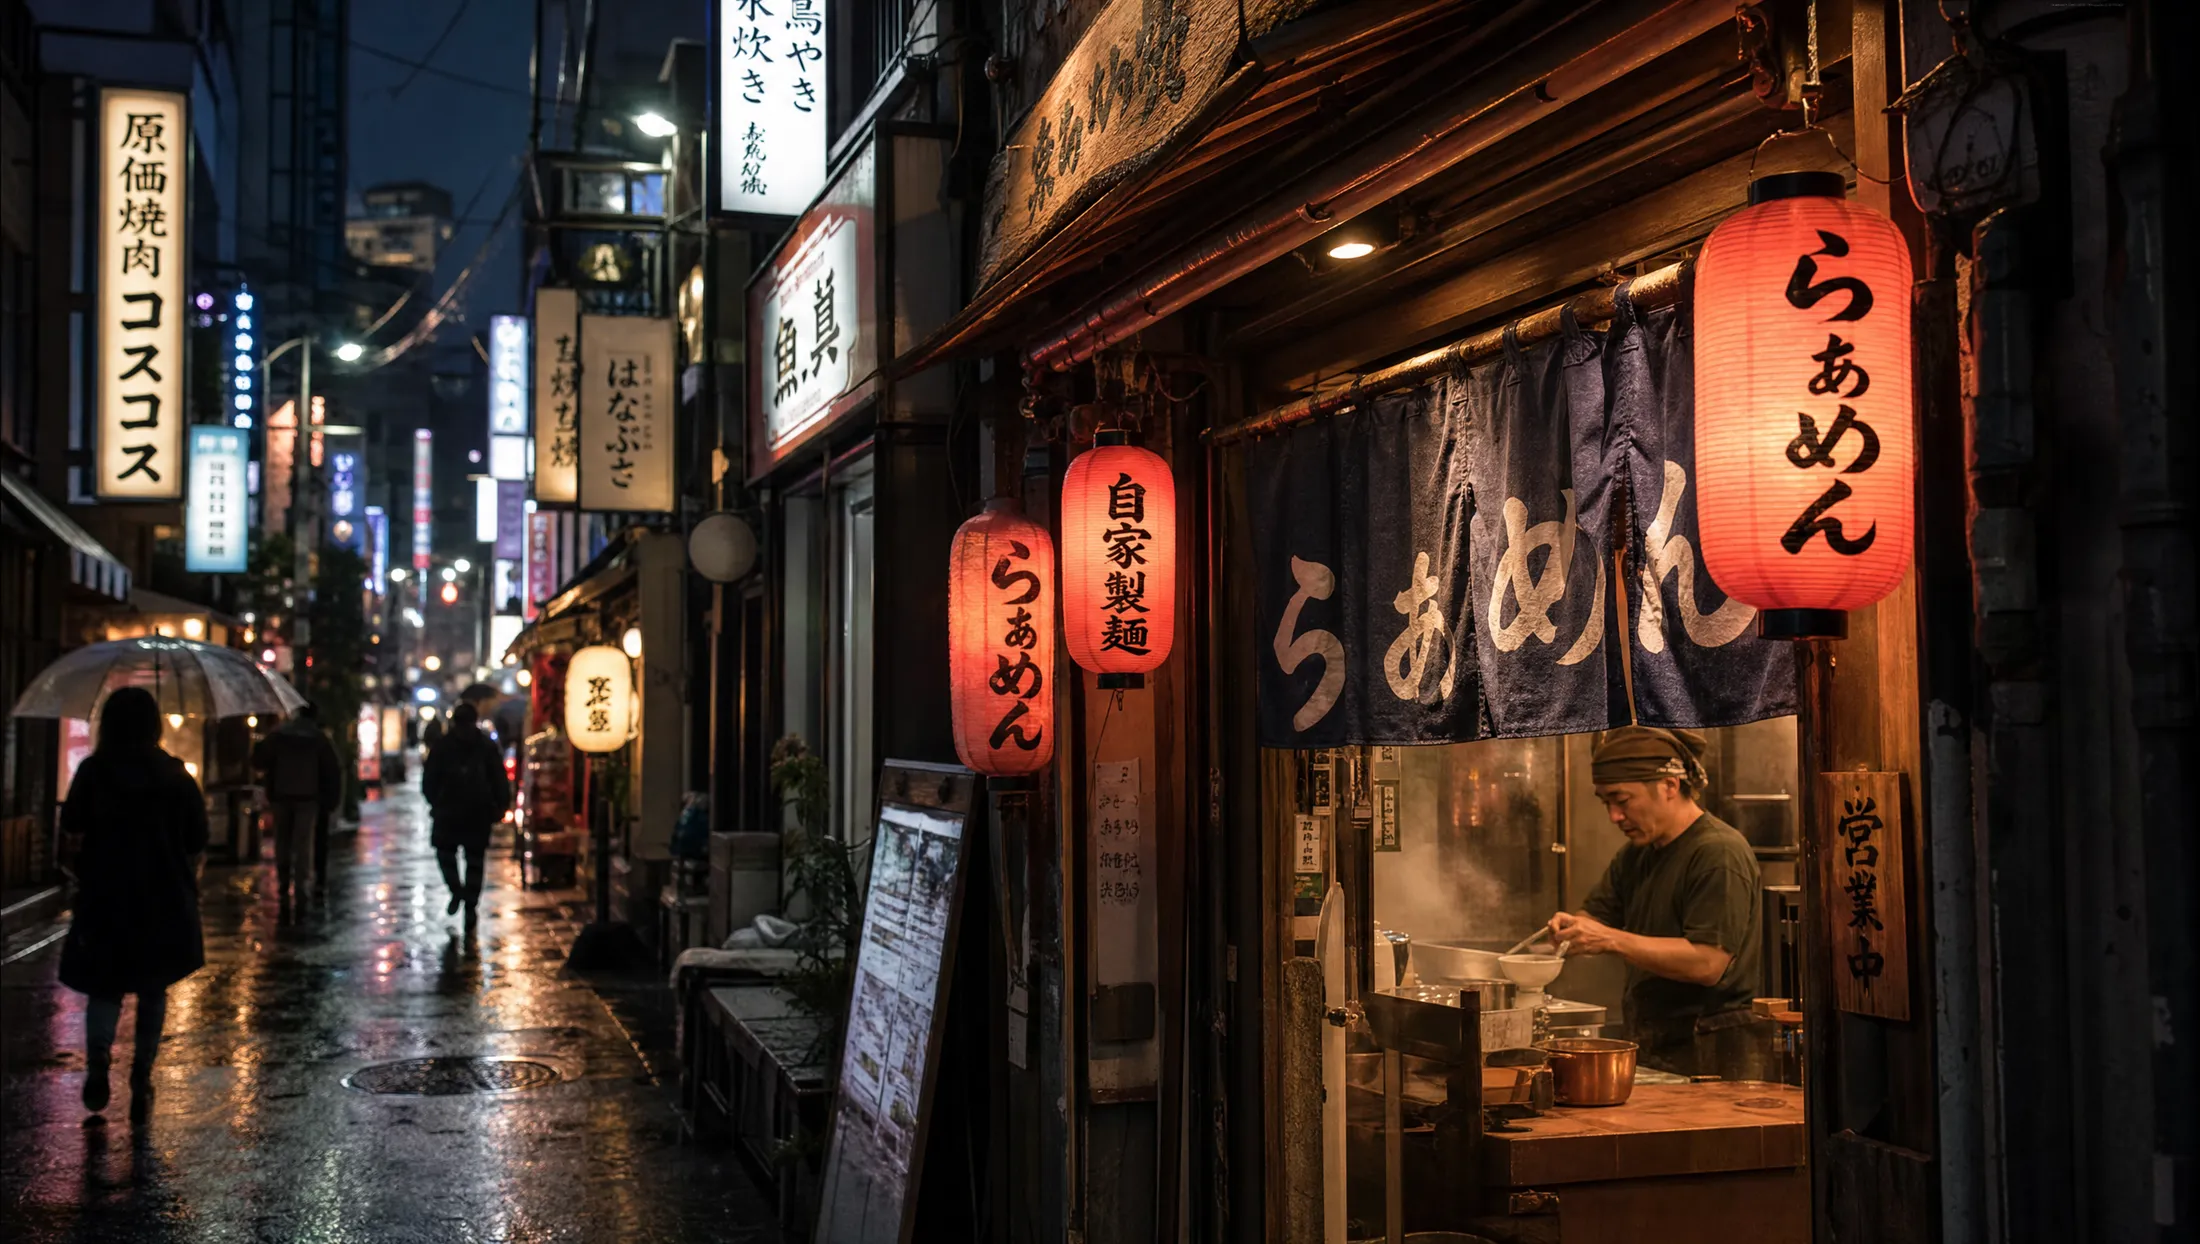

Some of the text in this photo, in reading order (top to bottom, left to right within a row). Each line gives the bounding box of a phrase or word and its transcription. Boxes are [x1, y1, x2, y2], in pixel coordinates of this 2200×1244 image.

[116, 111, 168, 484] 原価焼肉コスコス
[605, 358, 640, 490] はなぶさ
[1100, 472, 1153, 656] 自家製麺
[1838, 796, 1885, 994] 営業中
